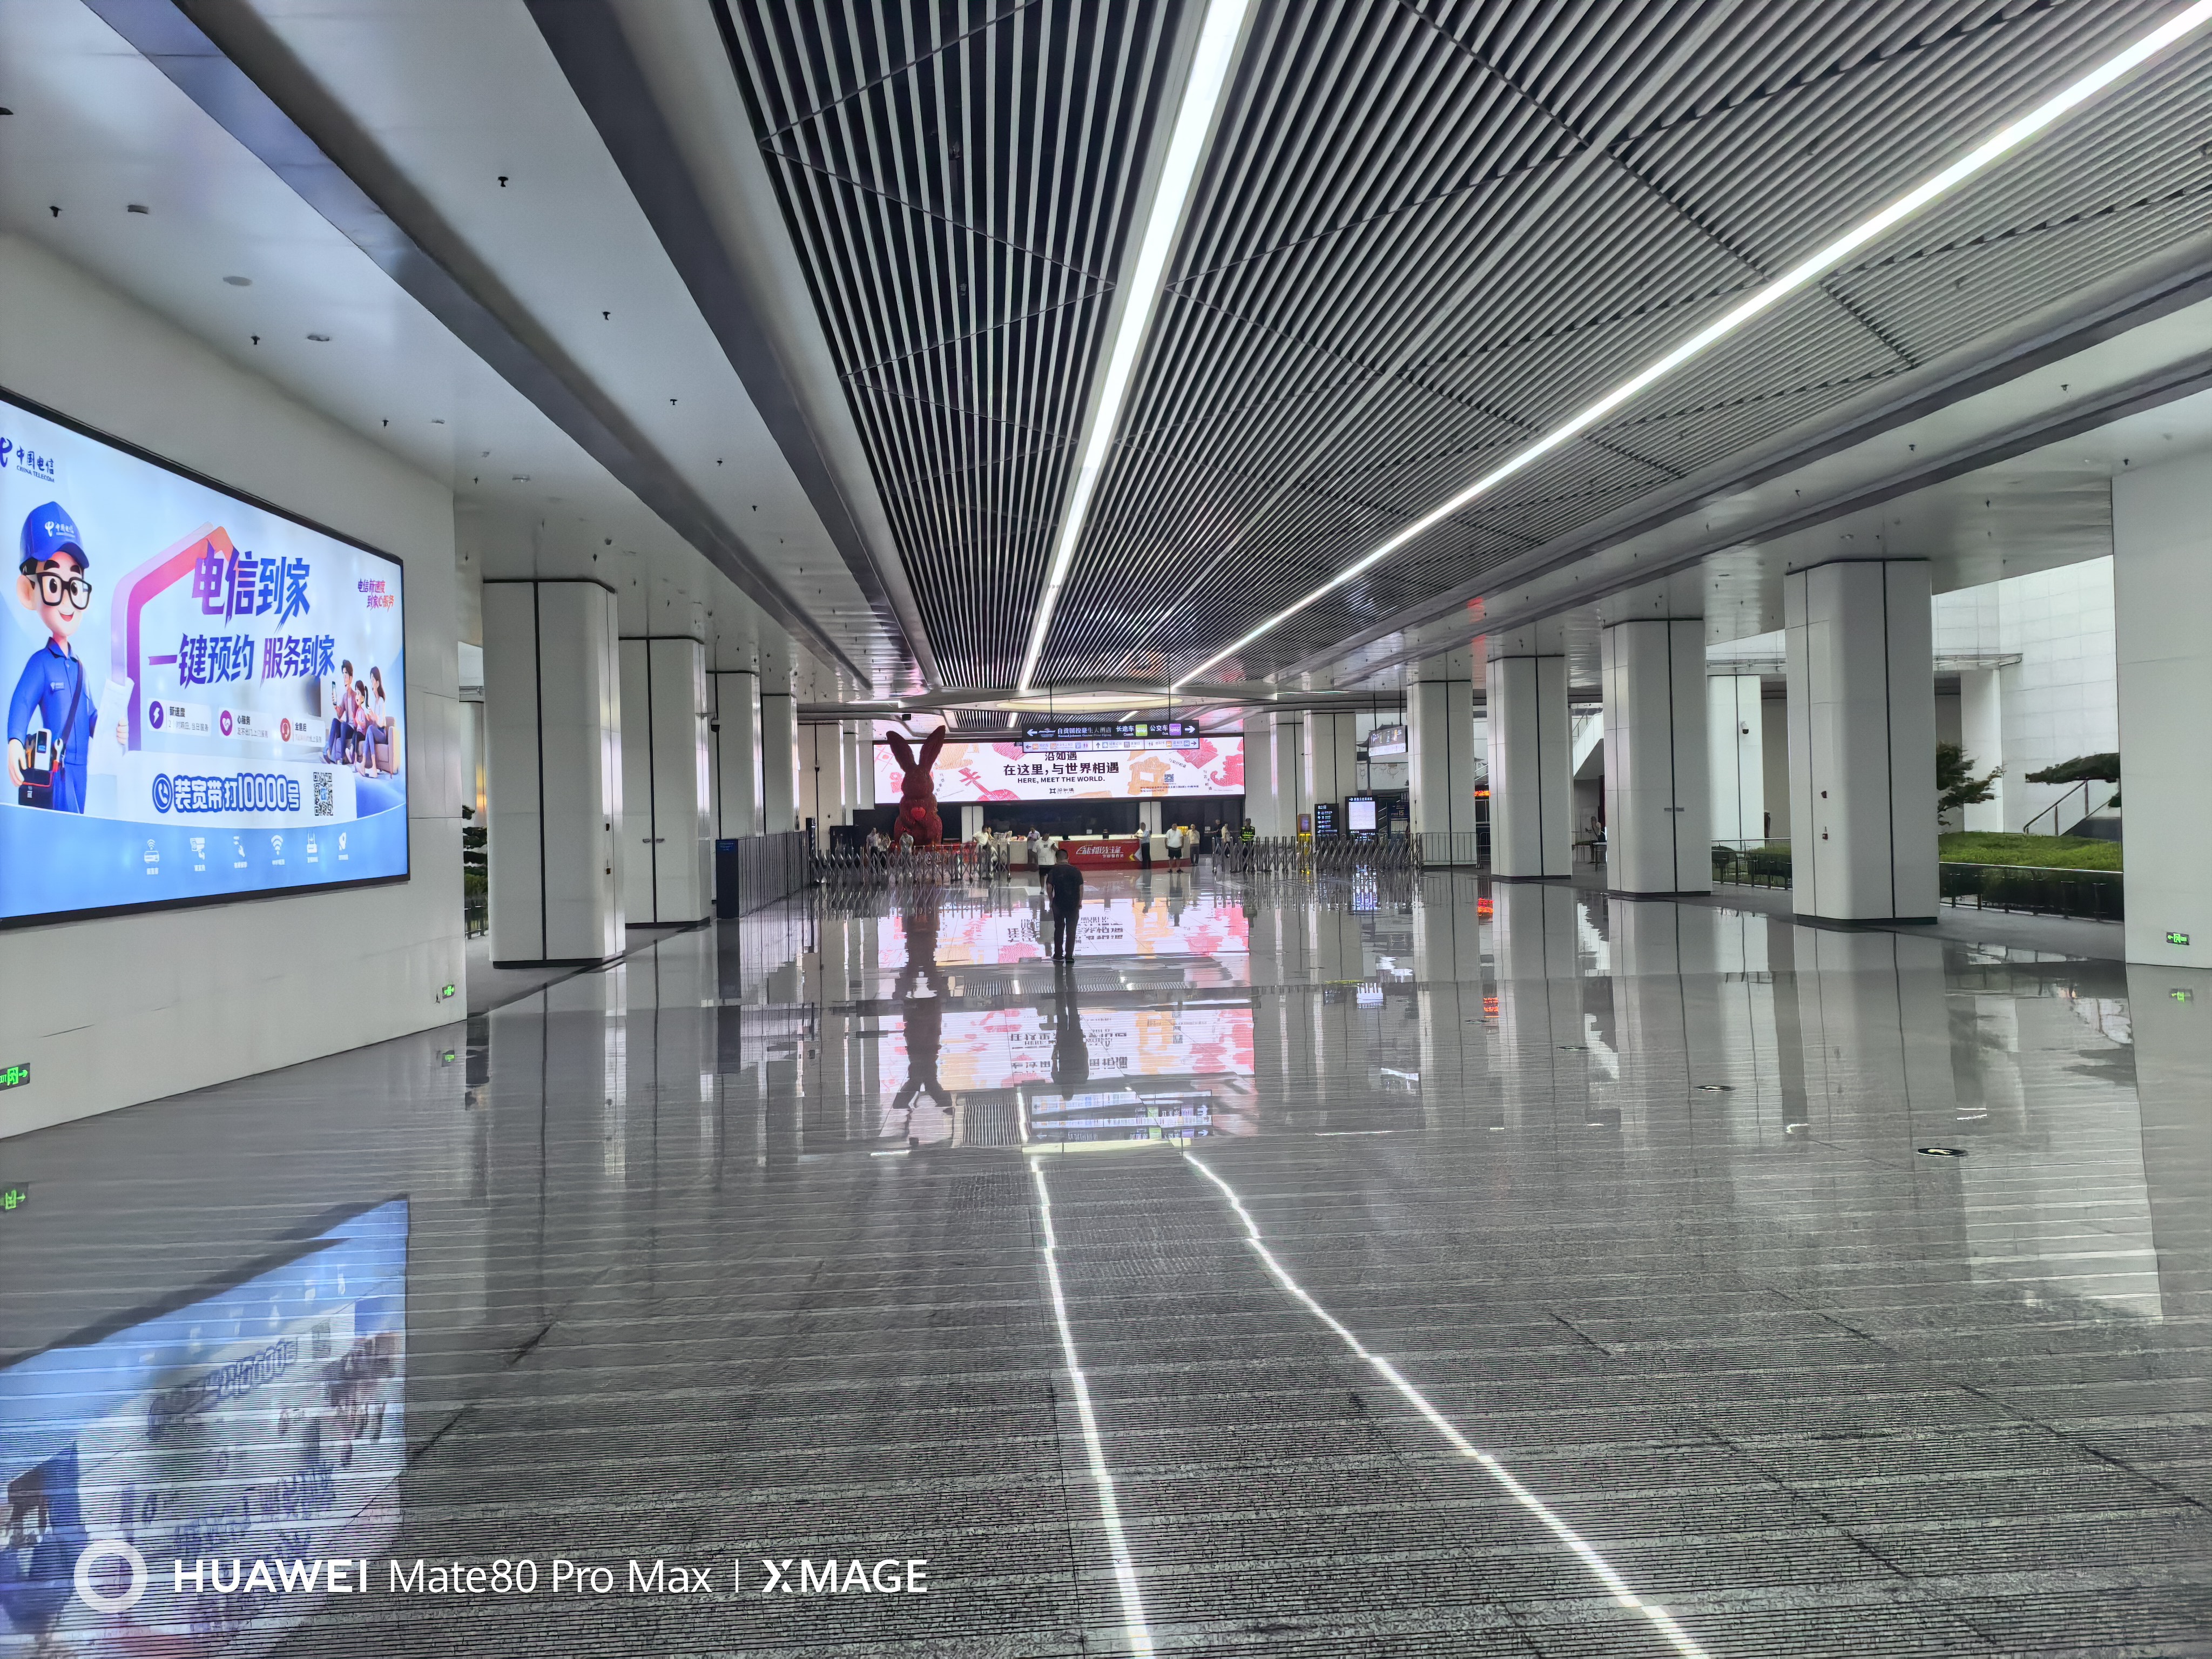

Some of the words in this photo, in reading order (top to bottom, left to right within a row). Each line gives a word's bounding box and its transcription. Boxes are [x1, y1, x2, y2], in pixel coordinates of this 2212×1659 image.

[16, 444, 54, 475] 中国电信
[17, 465, 32, 475] CHINA
[192, 538, 311, 635] 电信到家
[149, 633, 254, 689] 一键预约
[260, 634, 335, 690] 服务到家
[1044, 752, 1077, 761] 沿如遇
[173, 773, 300, 812] 装宽带打10000号
